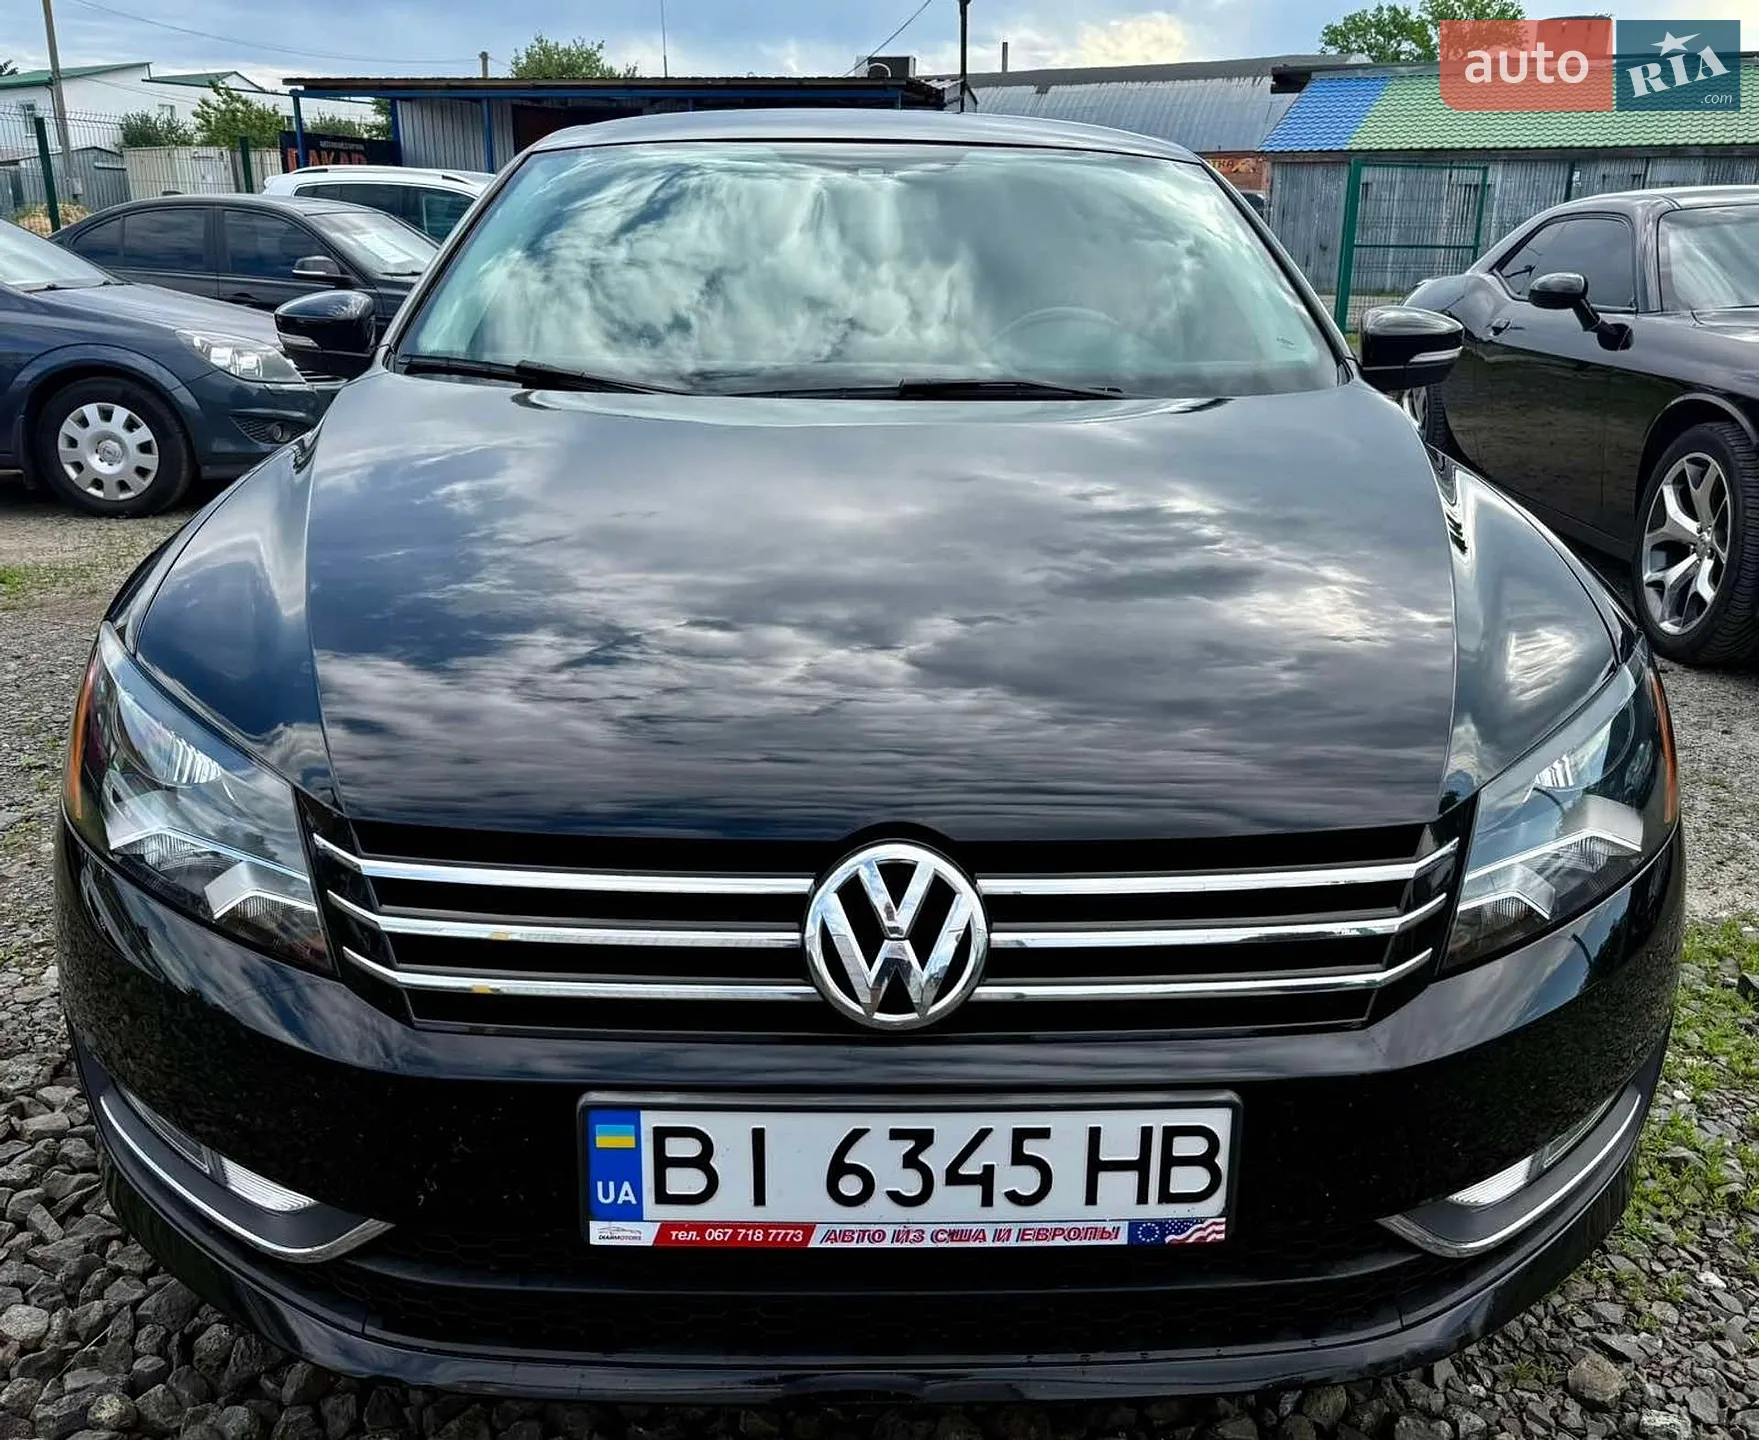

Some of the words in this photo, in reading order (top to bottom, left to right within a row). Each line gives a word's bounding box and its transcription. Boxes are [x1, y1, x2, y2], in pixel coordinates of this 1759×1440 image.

[825, 1127, 1054, 1208] 6345
[1084, 1125, 1223, 1206] HB
[596, 1181, 637, 1205] UA
[670, 1229, 701, 1241] тел.
[705, 1228, 733, 1241] 067
[737, 1228, 763, 1242] 718
[767, 1229, 803, 1243] 7773
[820, 1228, 887, 1245] АВТО
[930, 1228, 987, 1244] США
[992, 1227, 1012, 1243] И
[1016, 1225, 1120, 1243] ЕВРОПЫ
